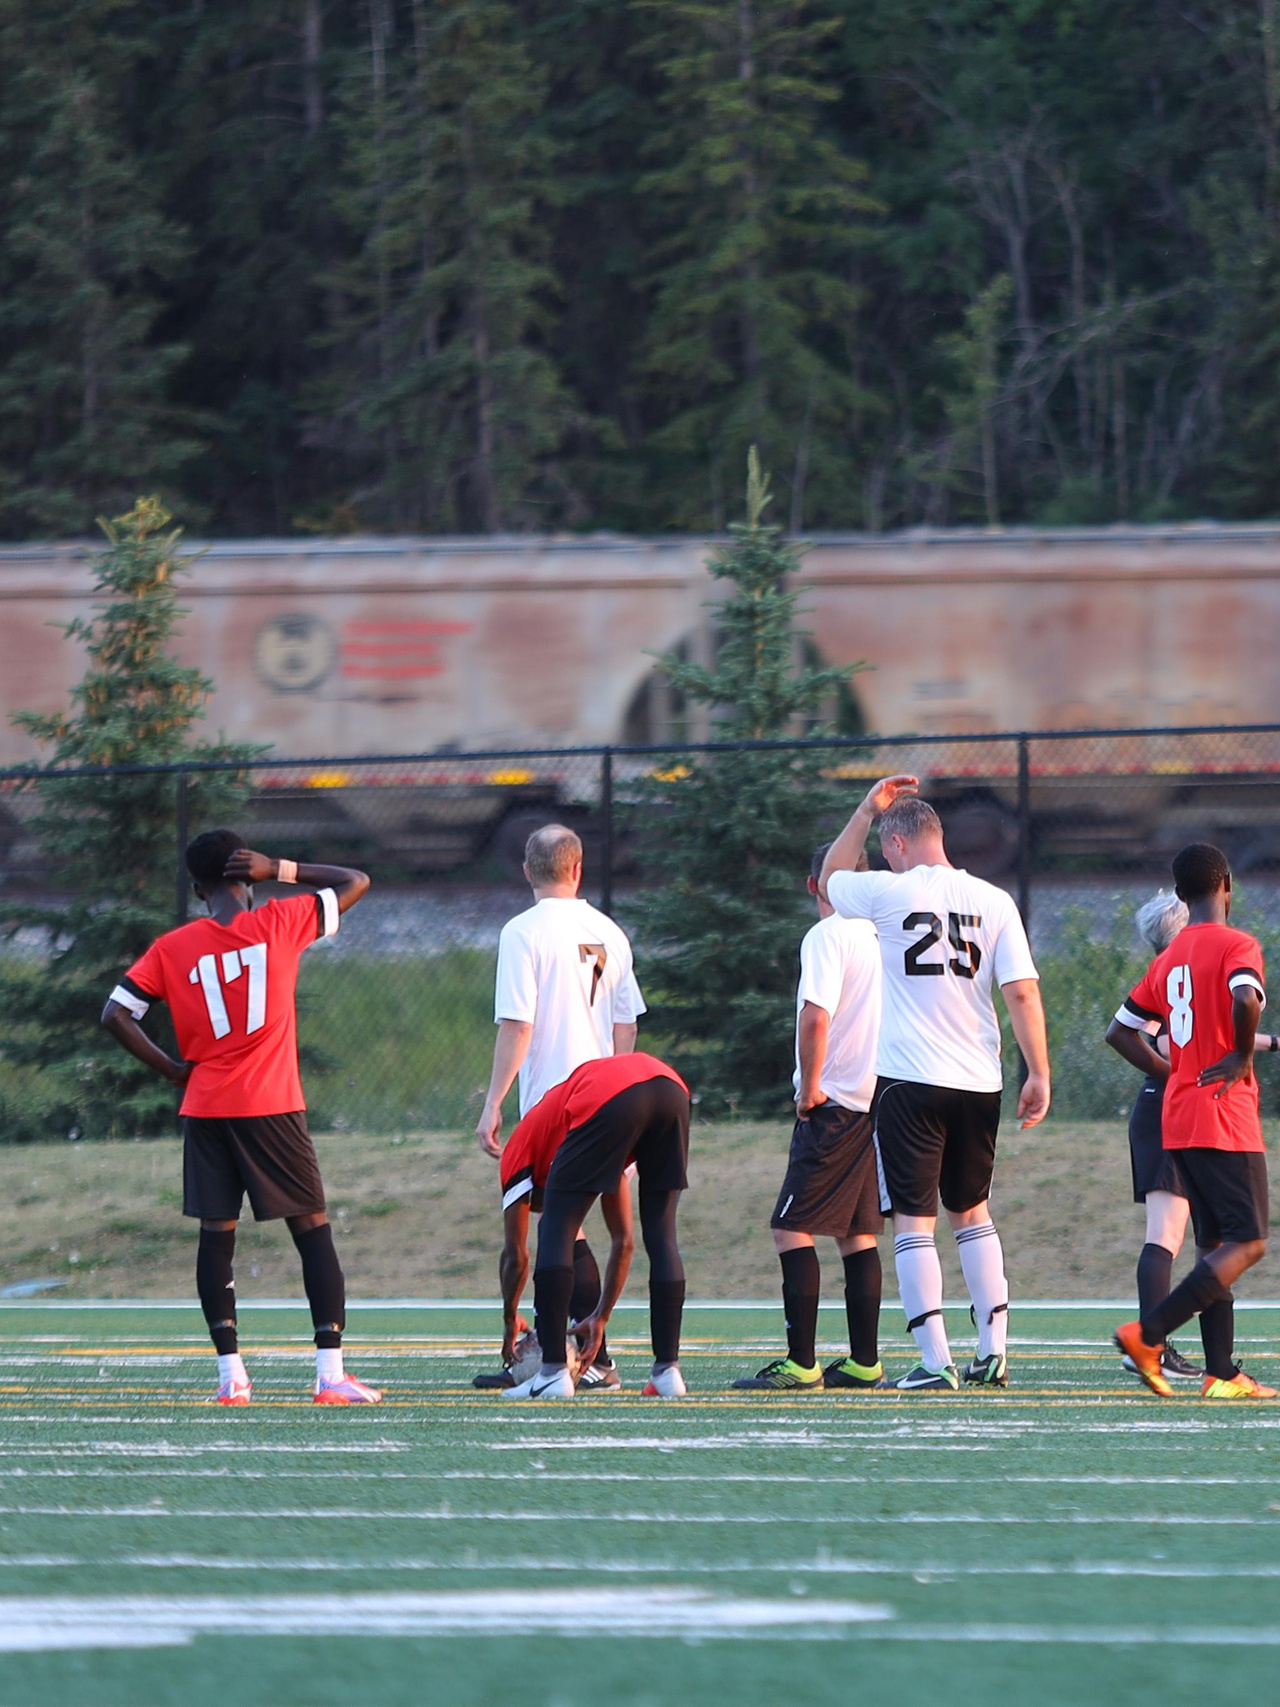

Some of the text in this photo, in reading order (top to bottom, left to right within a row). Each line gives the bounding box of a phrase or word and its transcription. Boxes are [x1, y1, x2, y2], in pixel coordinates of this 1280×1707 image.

[578, 944, 607, 1007] 7
[902, 912, 982, 979] 25
[188, 942, 268, 1040] 17
[1166, 964, 1193, 1049] 8
